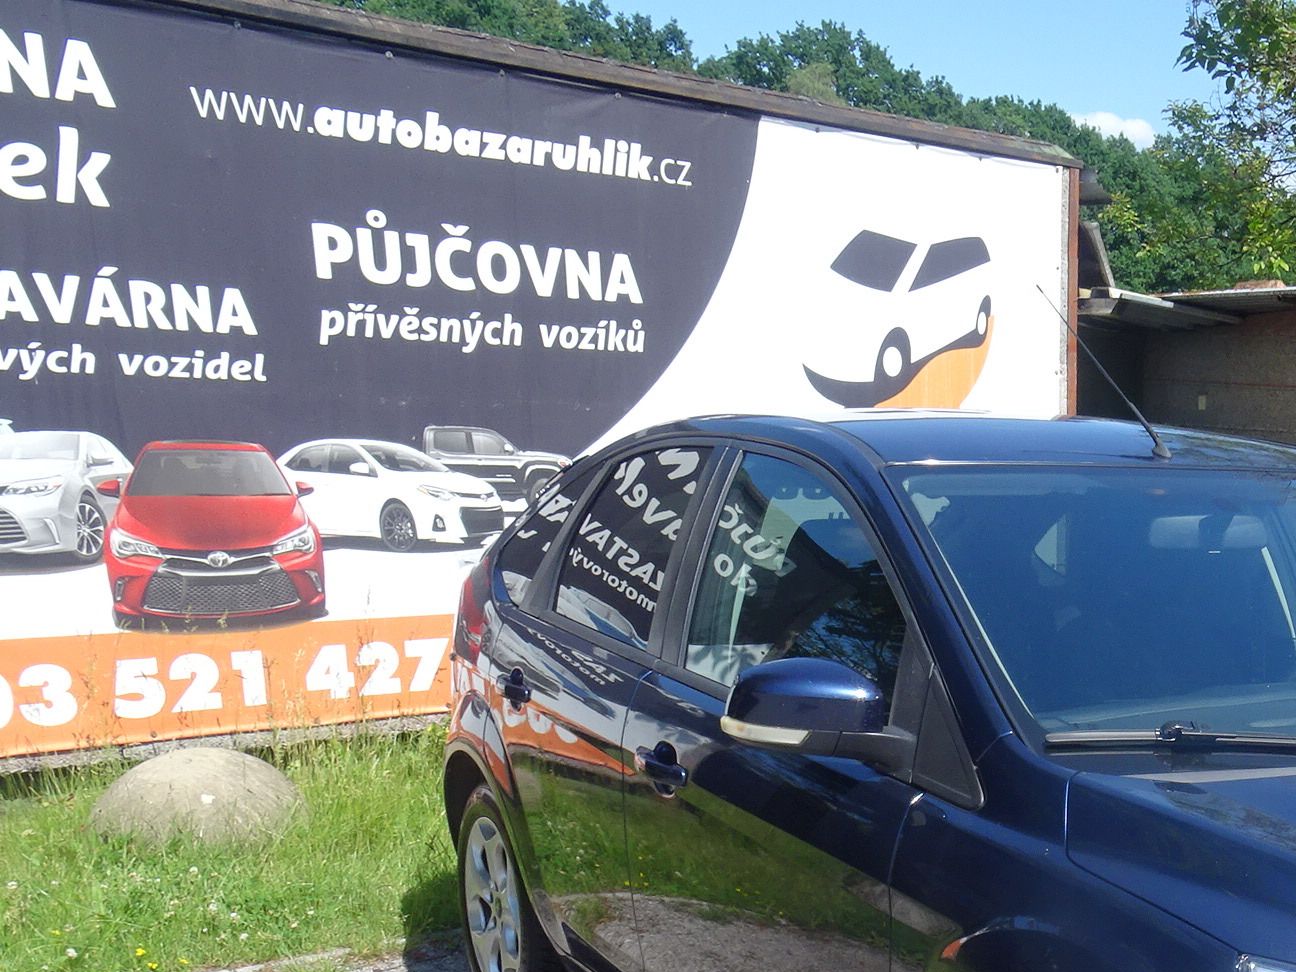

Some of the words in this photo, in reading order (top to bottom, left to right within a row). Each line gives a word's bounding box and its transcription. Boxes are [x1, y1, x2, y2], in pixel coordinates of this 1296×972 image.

[0, 28, 117, 108] NA
[0, 125, 111, 208] ek
[189, 86, 693, 187] www.autobazaruhlik.cz
[311, 209, 644, 304] PŮJČOVNA
[0, 266, 259, 336] AVÁRNA
[319, 302, 523, 354] přívěsných
[538, 318, 646, 353] vozíků
[117, 349, 267, 382] vozidel
[0, 663, 78, 729] 3
[115, 648, 268, 719] 521
[305, 637, 450, 700] 427
